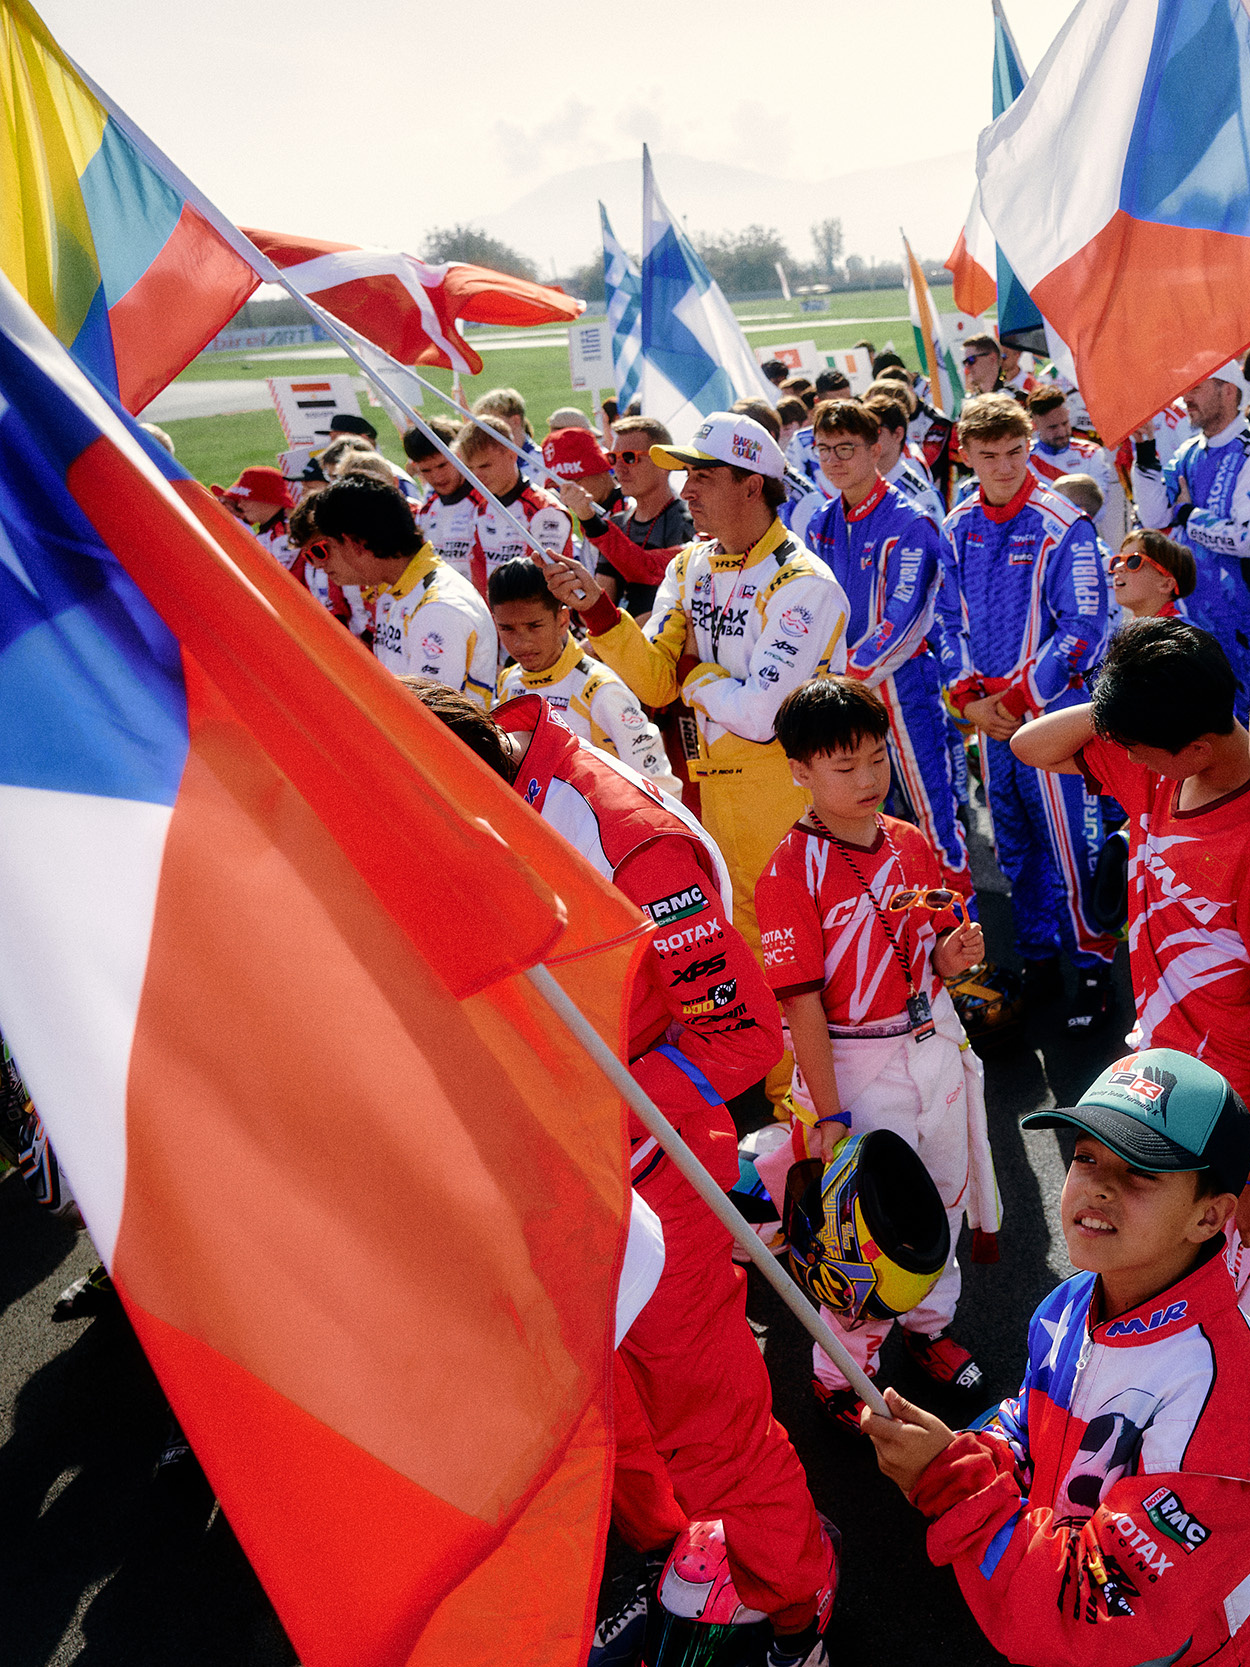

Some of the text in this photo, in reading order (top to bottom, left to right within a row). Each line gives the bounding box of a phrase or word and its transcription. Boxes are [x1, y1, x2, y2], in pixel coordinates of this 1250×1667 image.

[732, 434, 763, 453] BARRAN
[1190, 528, 1235, 546] estonia
[715, 560, 742, 569] HRX
[769, 569, 802, 592] HRX
[1070, 541, 1100, 616] REPUBLIC
[770, 639, 800, 656] XPS
[652, 888, 703, 918] RMC
[658, 914, 677, 926] CHILE
[652, 917, 722, 952] ROTAX
[668, 951, 727, 987] XPS
[1107, 1071, 1165, 1101] FK
[1108, 1089, 1124, 1099] Team
[1125, 1095, 1152, 1112] Formula
[1151, 1108, 1161, 1116] K
[1105, 1299, 1189, 1338] MIR
[956, 1361, 984, 1388] OMP
[1146, 1488, 1170, 1508] ROTAX
[1160, 1495, 1206, 1543] RMC
